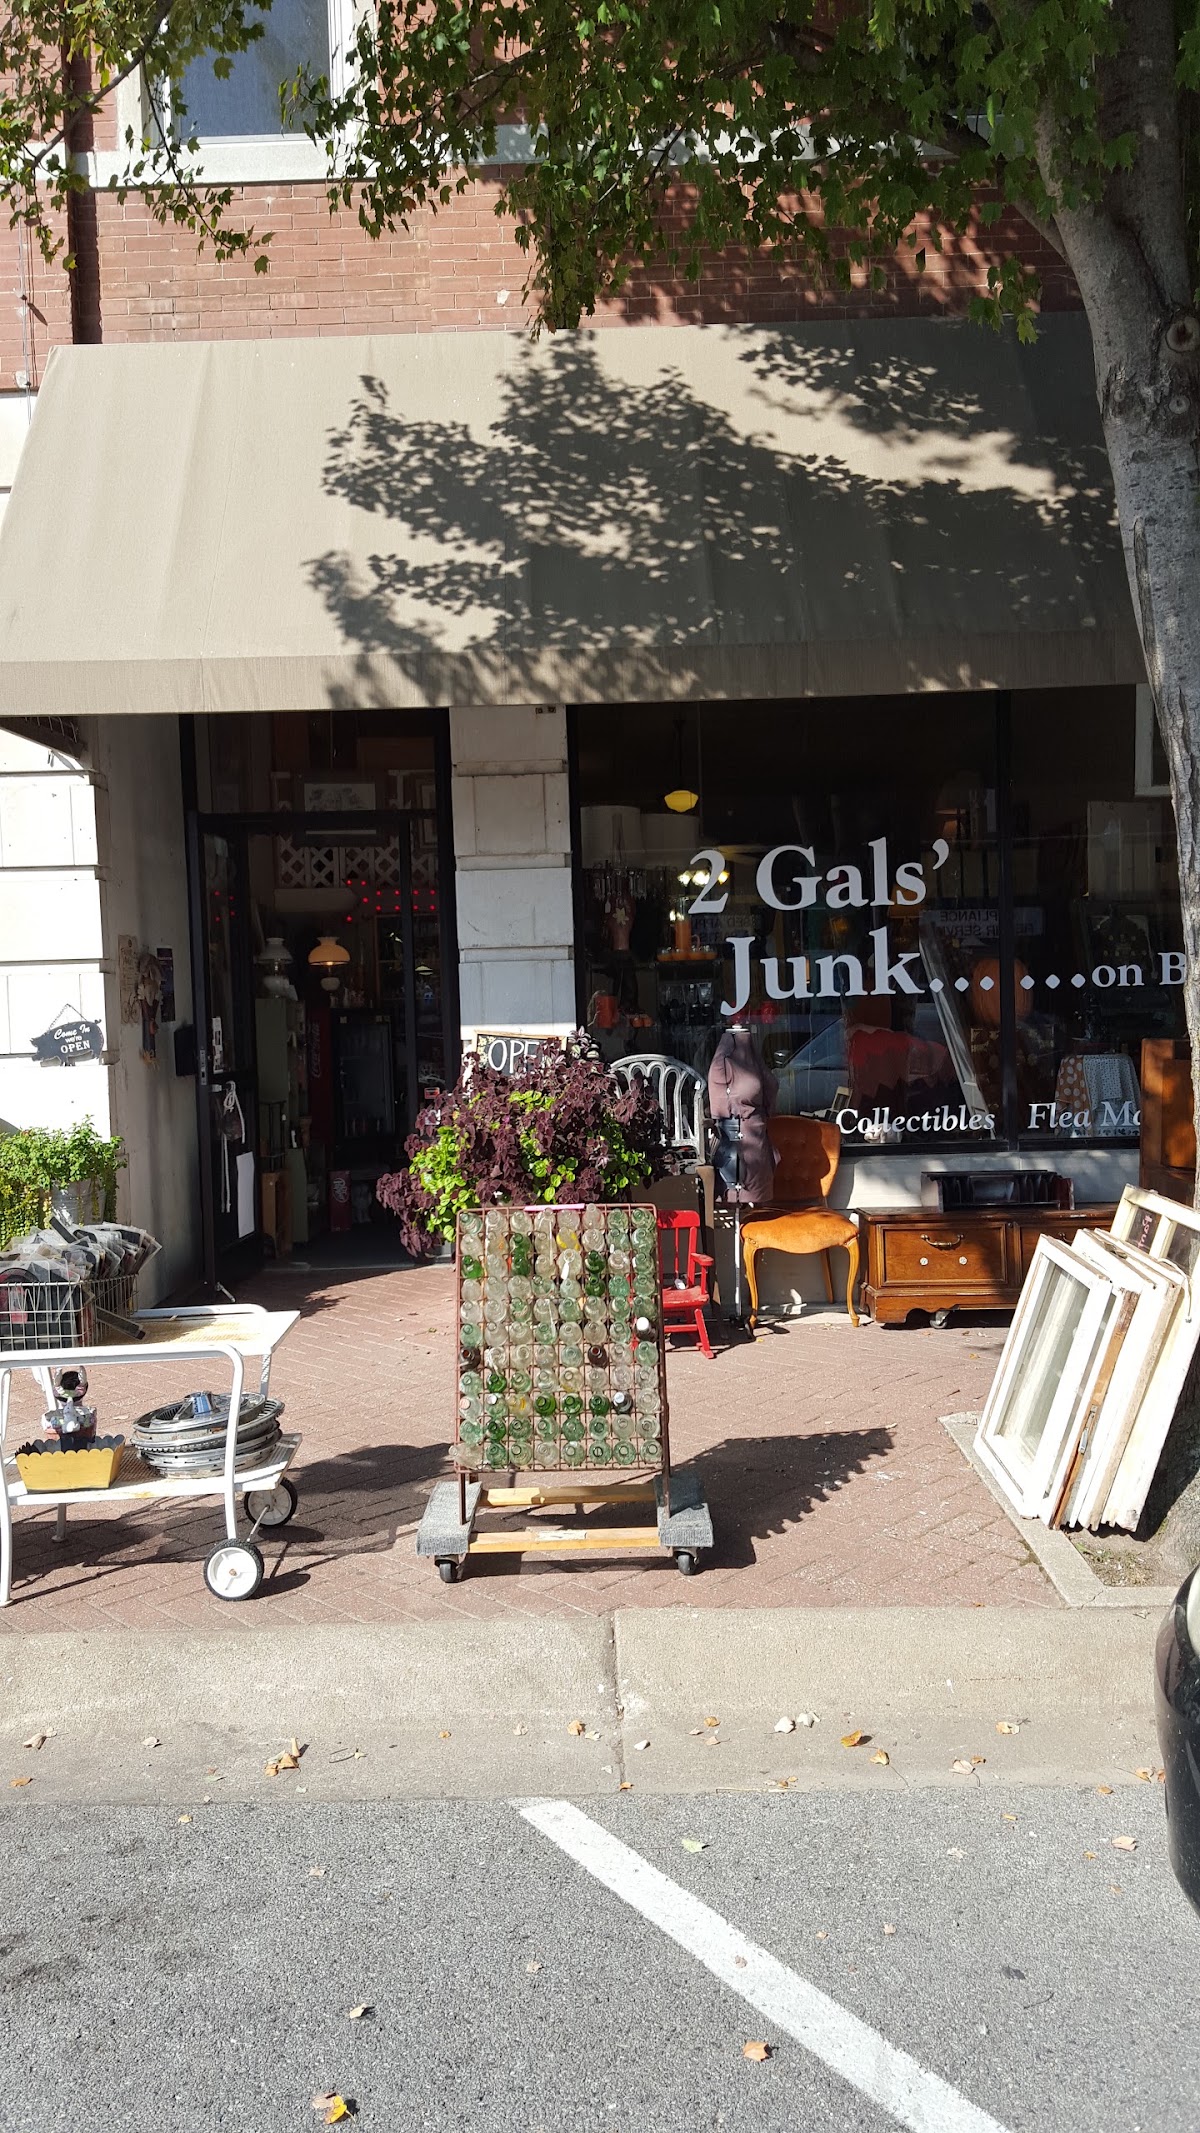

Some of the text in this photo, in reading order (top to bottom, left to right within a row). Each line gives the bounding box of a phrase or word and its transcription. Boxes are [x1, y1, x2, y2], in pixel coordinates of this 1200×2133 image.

[688, 849, 729, 914] 2
[54, 1024, 91, 1040] Come In
[61, 1040, 91, 1053] OPEN
[488, 1039, 547, 1074] OPE
[835, 1104, 996, 1134] Collectibles
[1028, 1101, 1092, 1130] Flea
